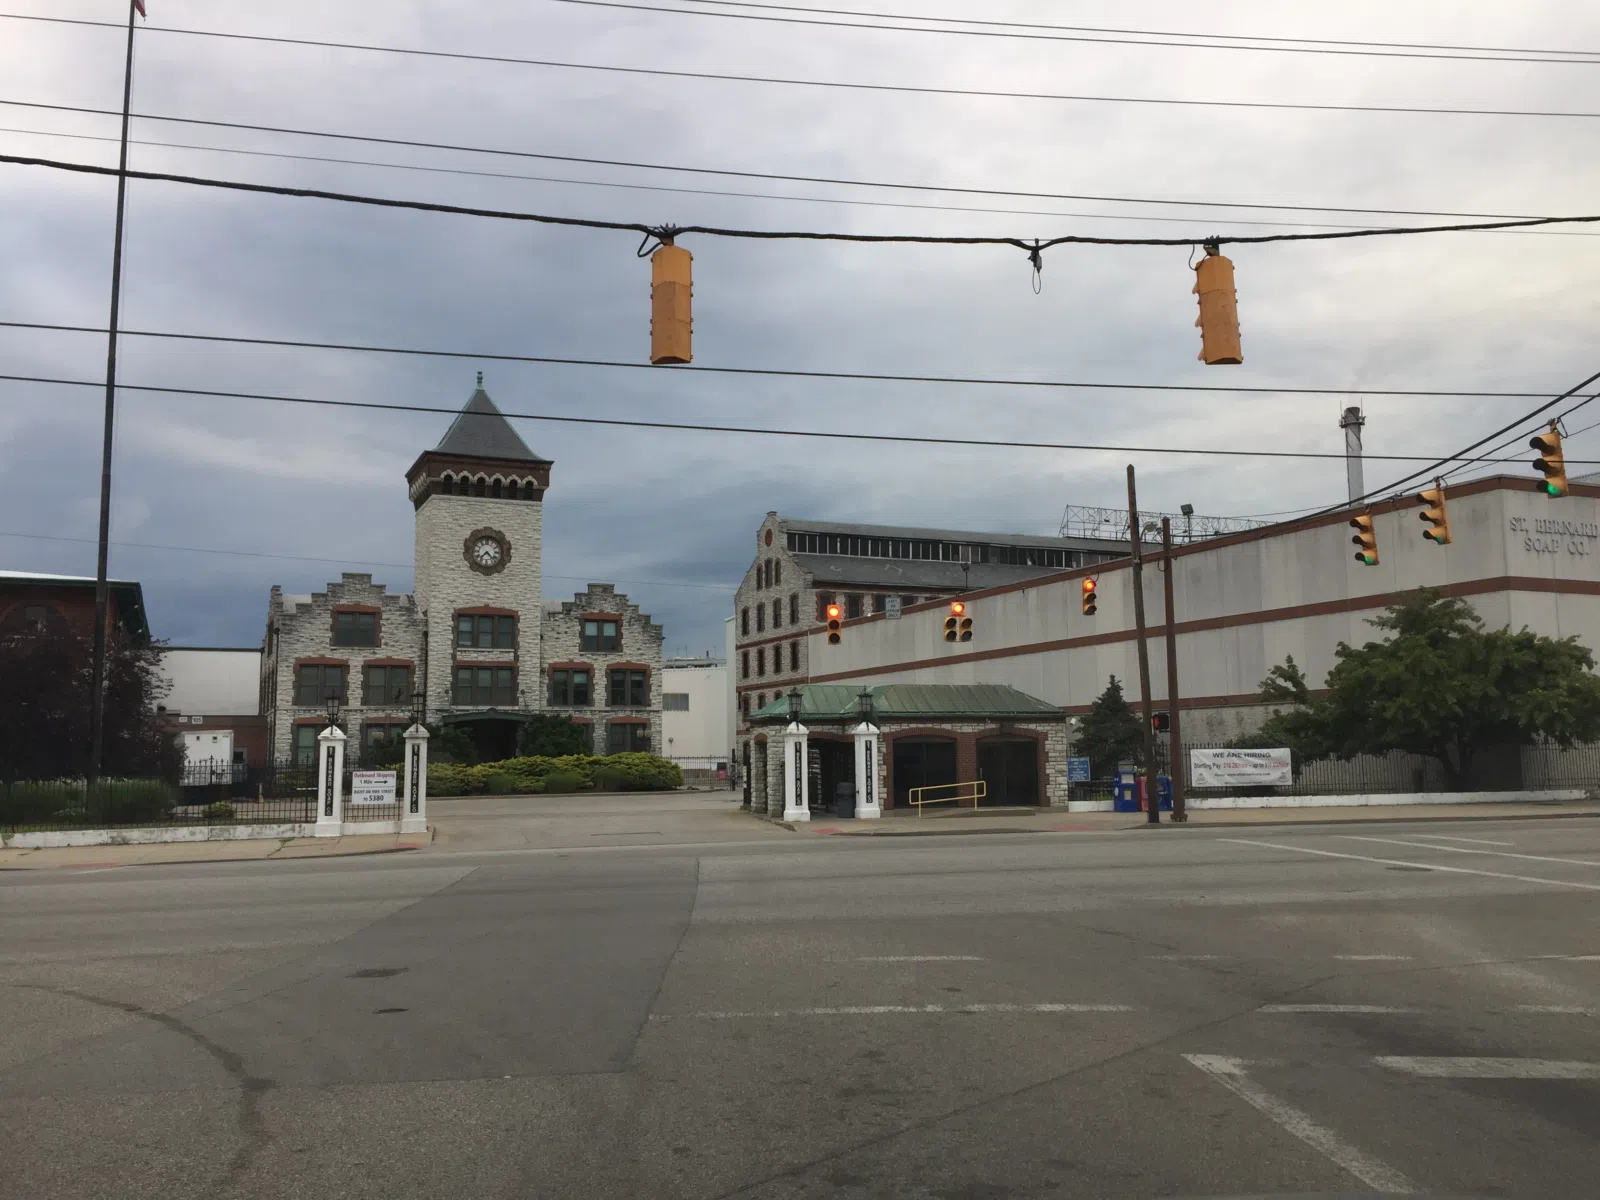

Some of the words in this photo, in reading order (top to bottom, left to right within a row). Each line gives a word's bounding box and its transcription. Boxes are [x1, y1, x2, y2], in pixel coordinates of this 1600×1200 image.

[1535, 518, 1598, 538] BERNARD
[1524, 537, 1560, 553] SOAP
[1567, 541, 1590, 556] CO.
